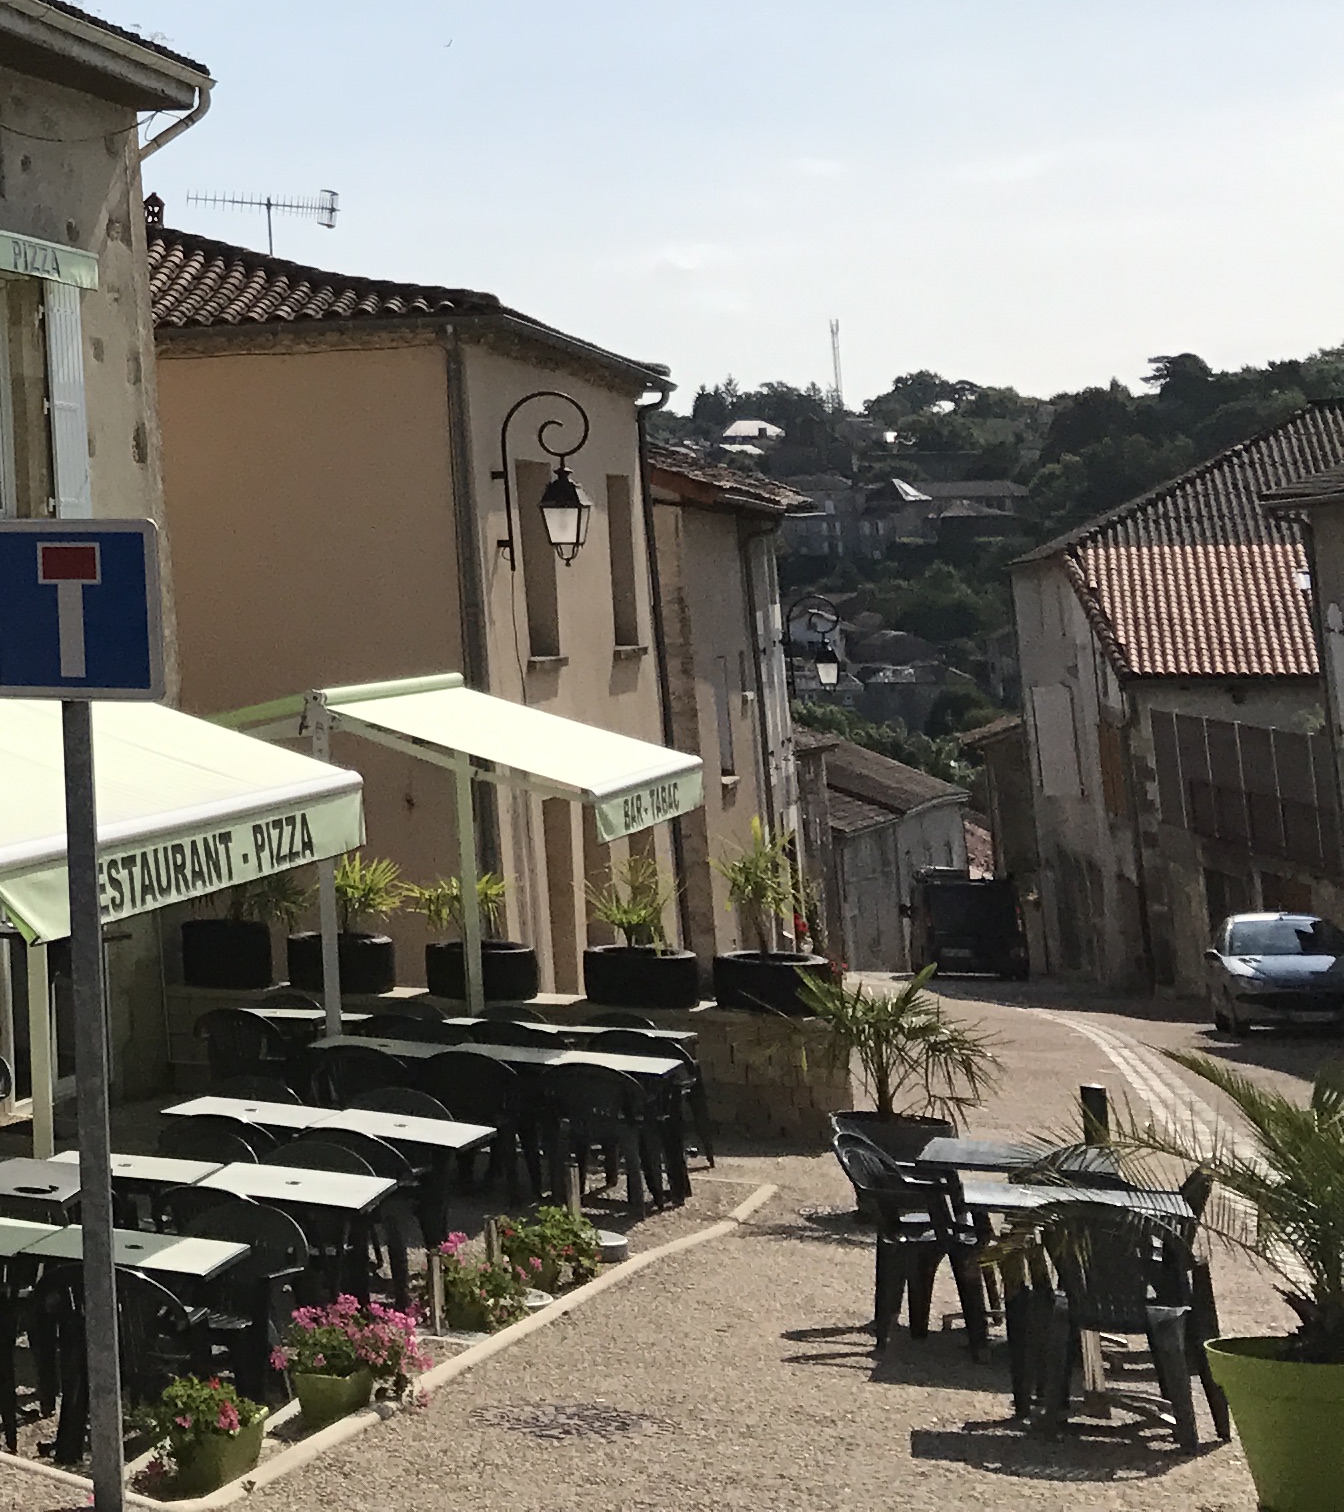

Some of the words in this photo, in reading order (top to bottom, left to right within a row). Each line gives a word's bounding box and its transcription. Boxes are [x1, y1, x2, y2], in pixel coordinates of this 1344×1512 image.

[12, 240, 61, 278] PIZZA
[98, 831, 234, 916] ESTAURANT
[252, 812, 315, 872] PIZZA
